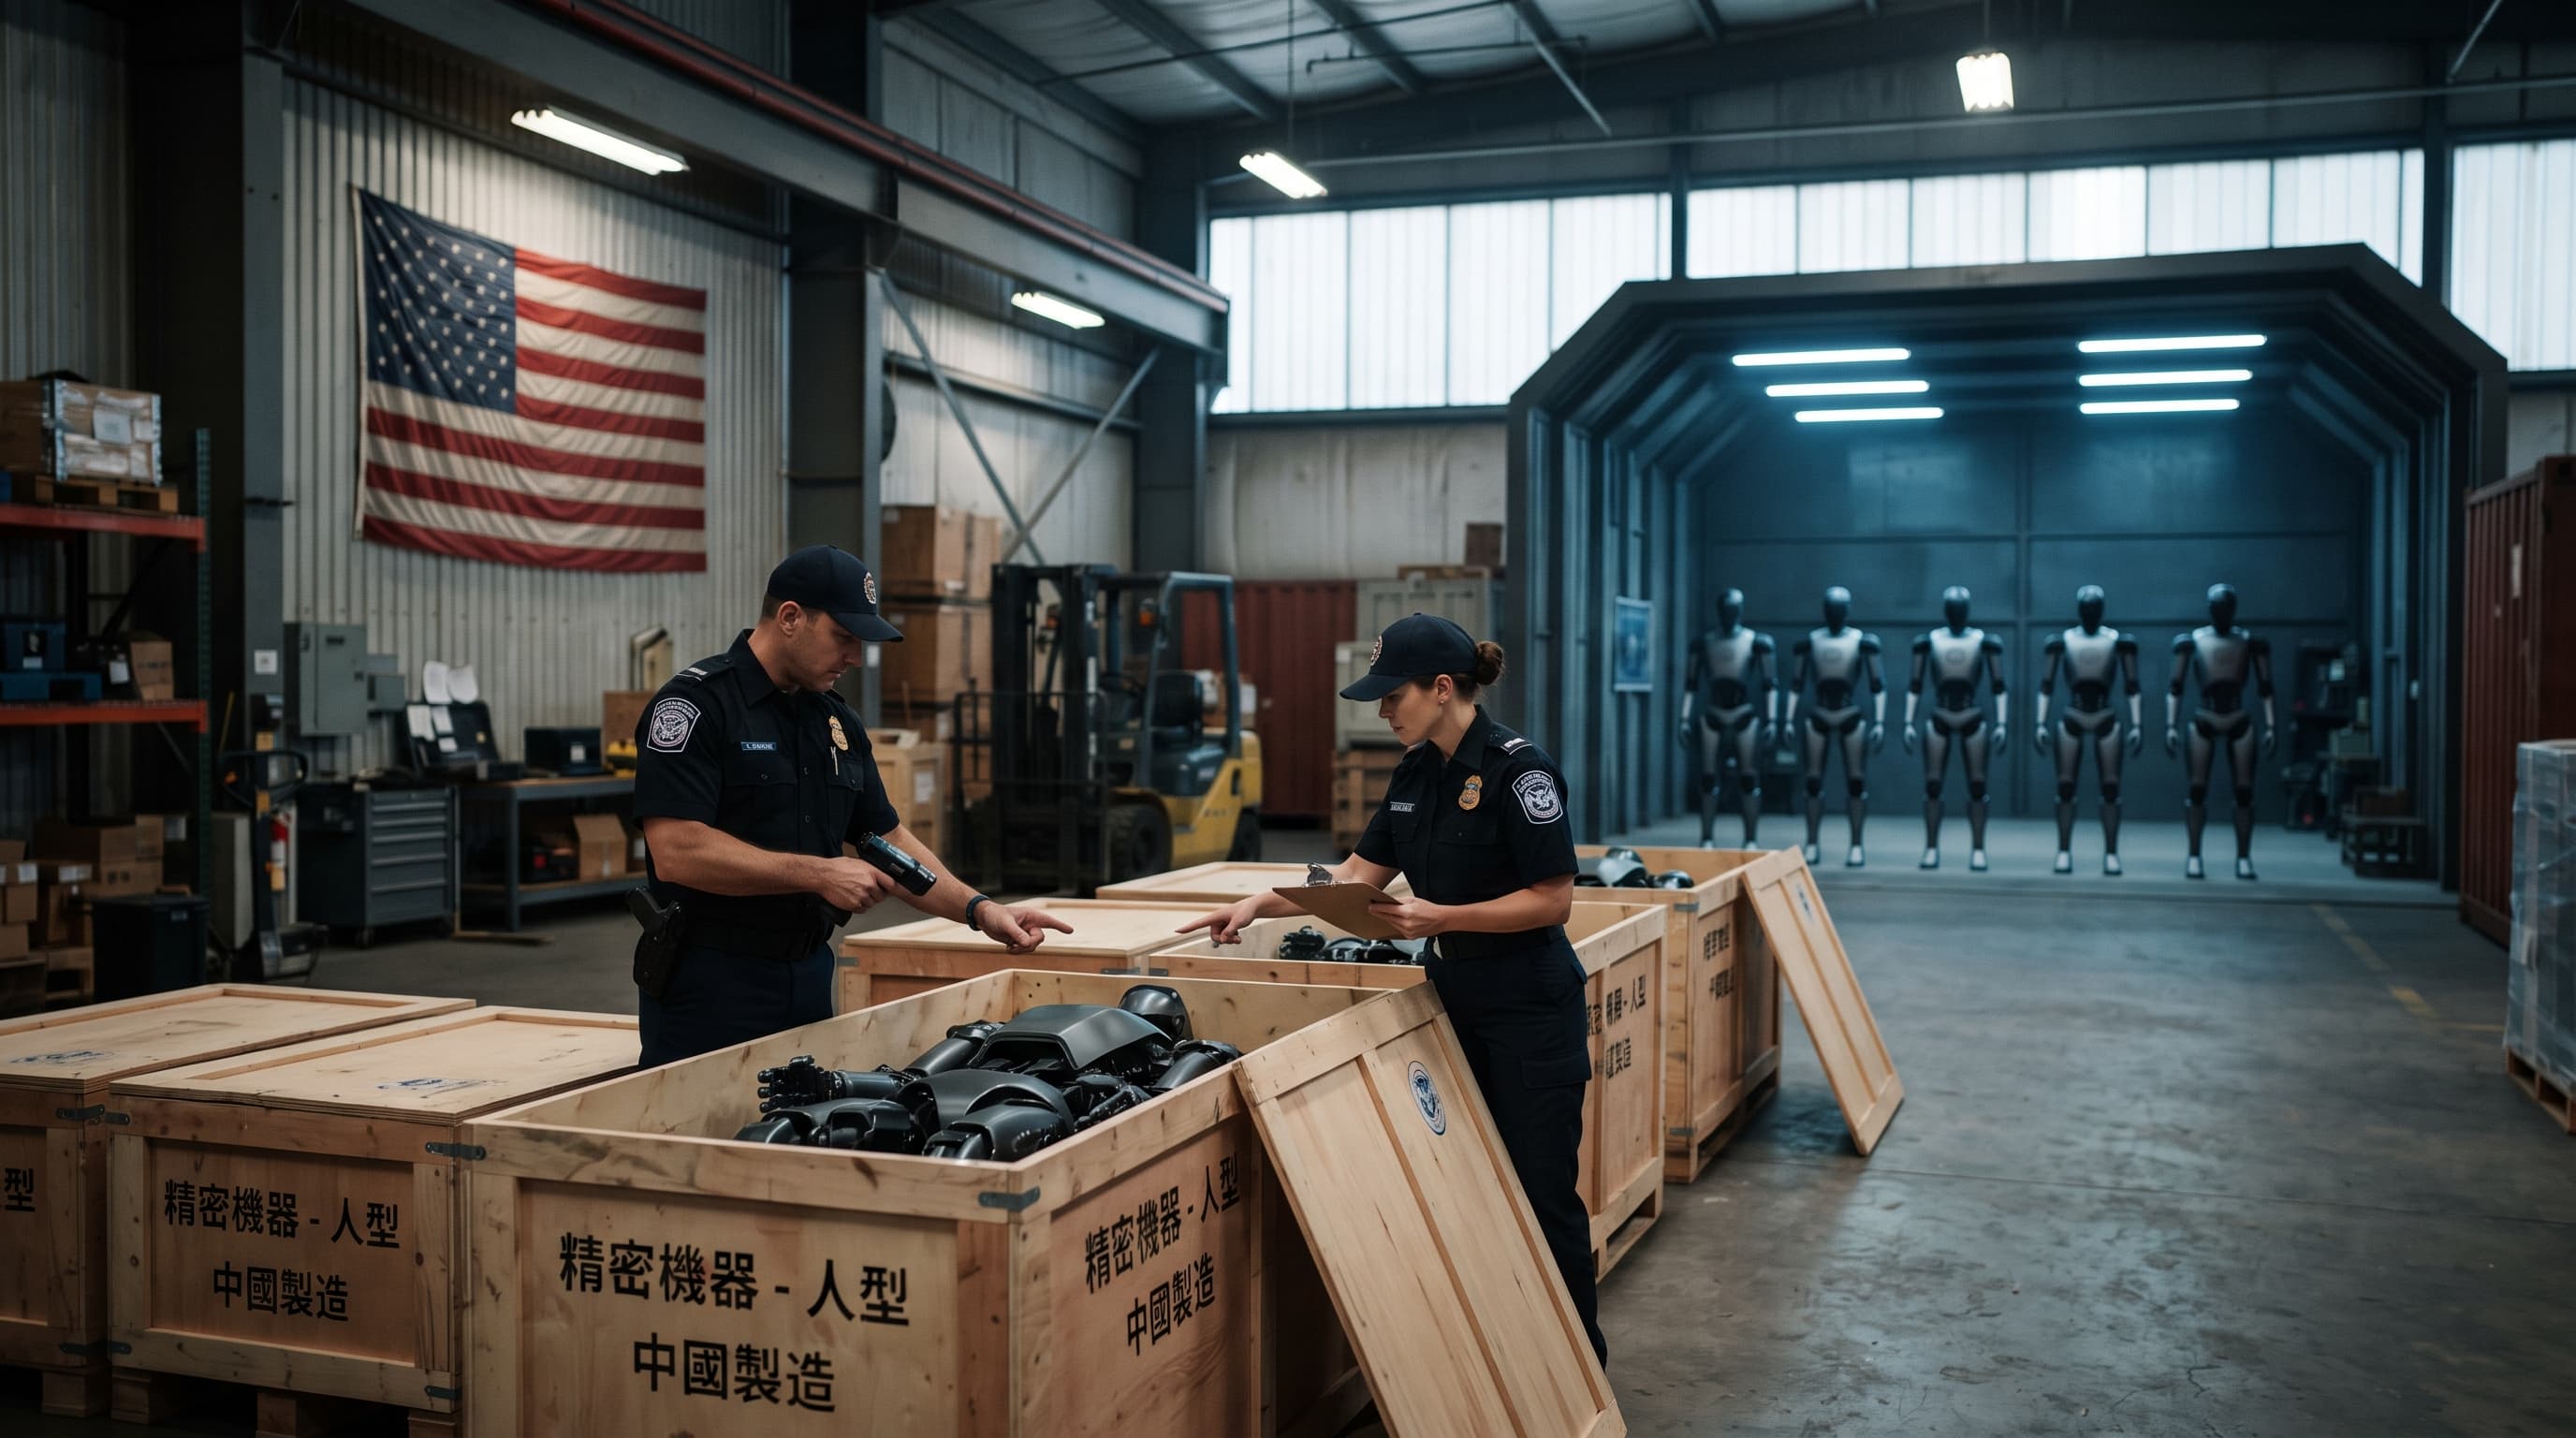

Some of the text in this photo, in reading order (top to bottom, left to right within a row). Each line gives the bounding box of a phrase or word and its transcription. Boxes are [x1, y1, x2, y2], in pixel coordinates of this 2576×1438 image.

[4, 1167, 36, 1212] 型
[164, 1179, 300, 1240] 精密機器
[330, 1197, 401, 1249] 人型
[1084, 1185, 1181, 1295] 精密機器
[1200, 1152, 1241, 1224] 人型
[212, 1261, 349, 1322] 中國製造
[559, 1231, 759, 1311] 精密機器
[807, 1259, 910, 1327] 人型
[1127, 1251, 1216, 1357] 中國製造
[634, 1332, 836, 1413] 中國製造
